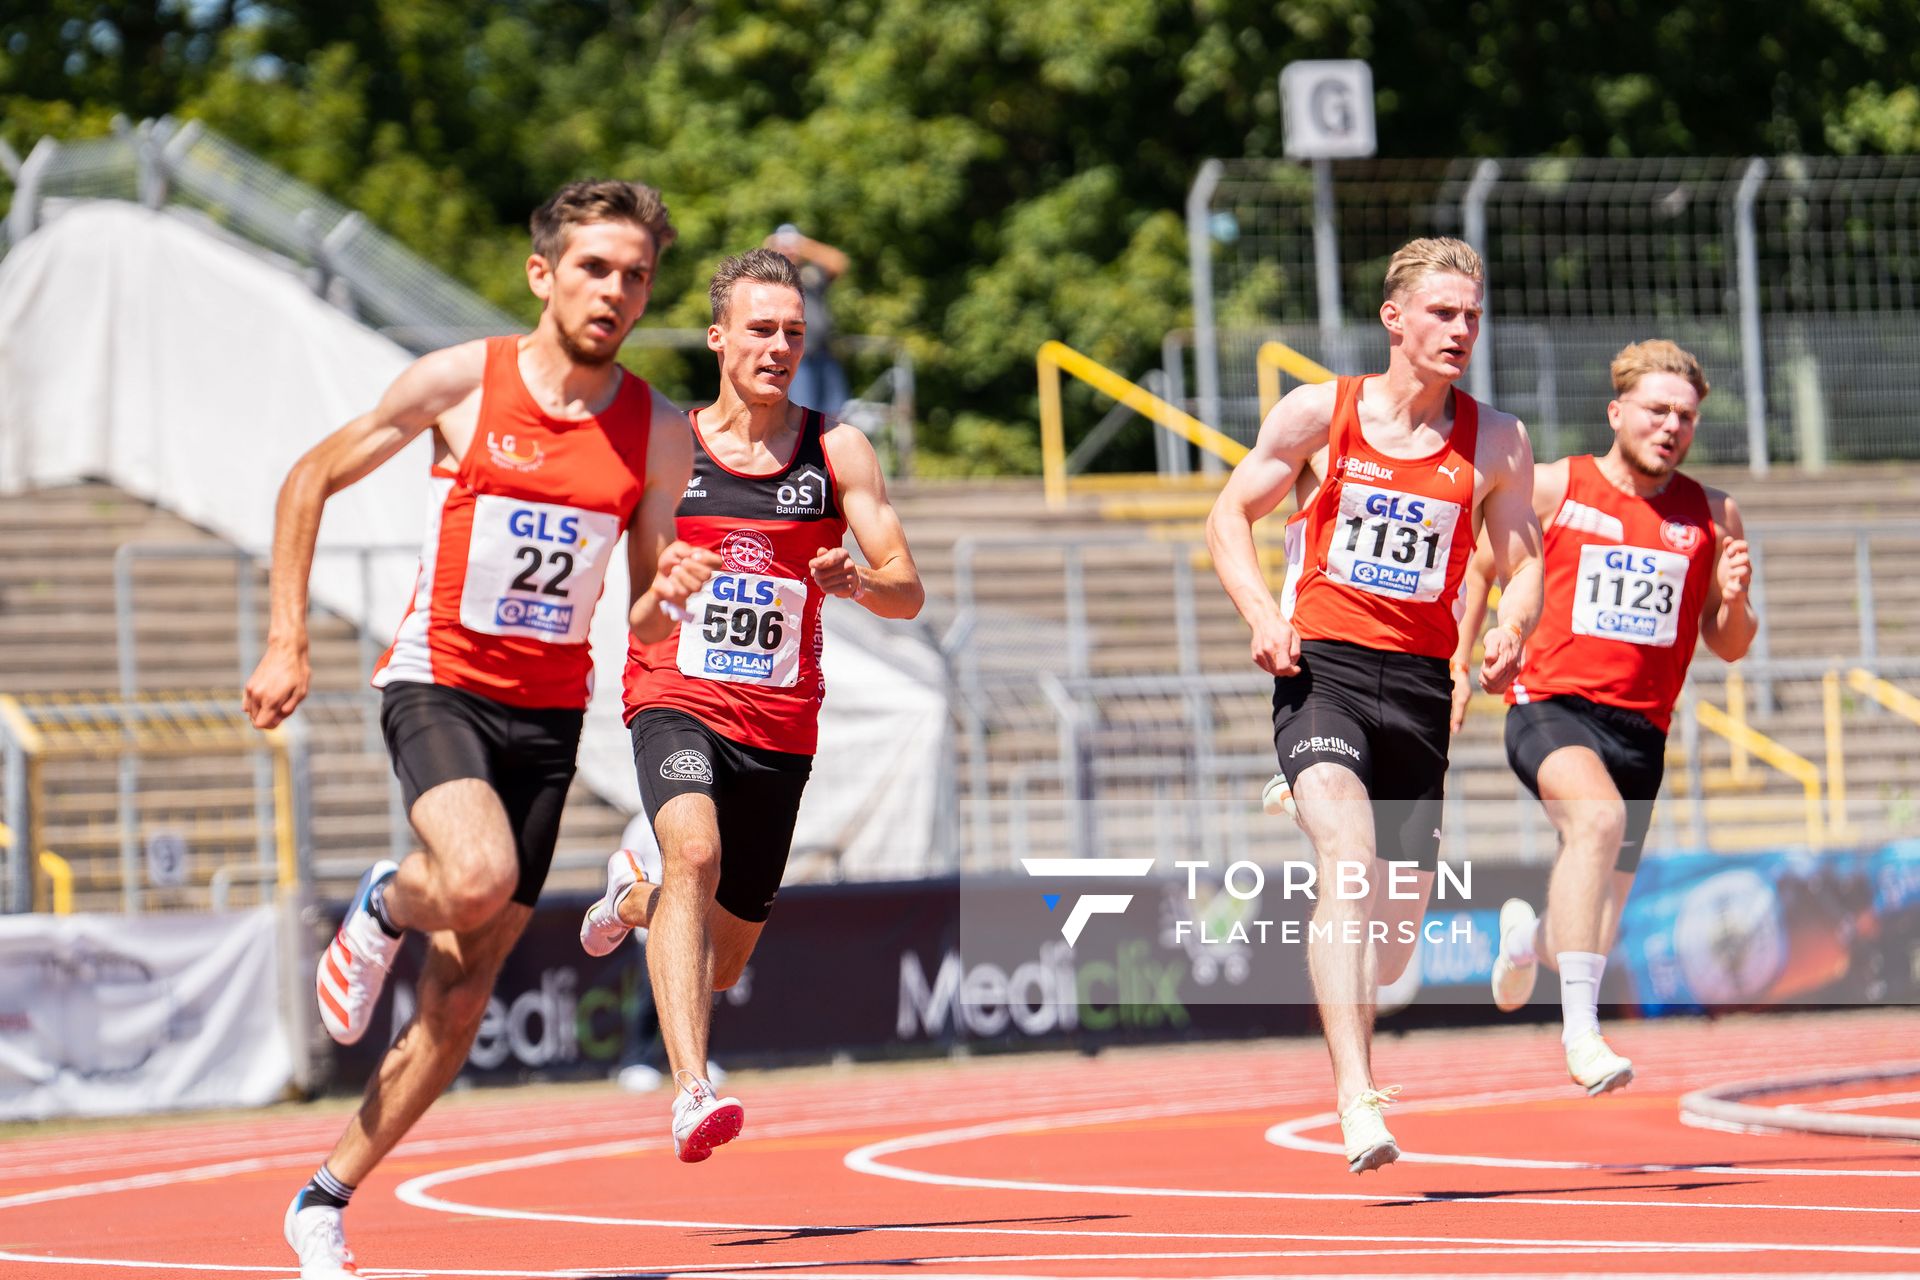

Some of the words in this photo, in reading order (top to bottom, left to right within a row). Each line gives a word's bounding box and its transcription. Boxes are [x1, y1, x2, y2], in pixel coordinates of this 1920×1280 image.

[1309, 78, 1356, 139] G
[1348, 457, 1394, 481] Brillux
[682, 489, 707, 498] rima
[776, 485, 813, 505] OS
[776, 505, 821, 515] BauImmo
[1345, 515, 1441, 569] 1131
[510, 546, 575, 598] 22
[1379, 570, 1418, 586] PLAN
[1586, 571, 1674, 614] 1123
[526, 603, 571, 625] PLAN
[702, 603, 784, 651] 596
[732, 655, 771, 671] PLAN
[1310, 736, 1361, 761] Brillux
[896, 940, 1192, 1038] Mediclix
